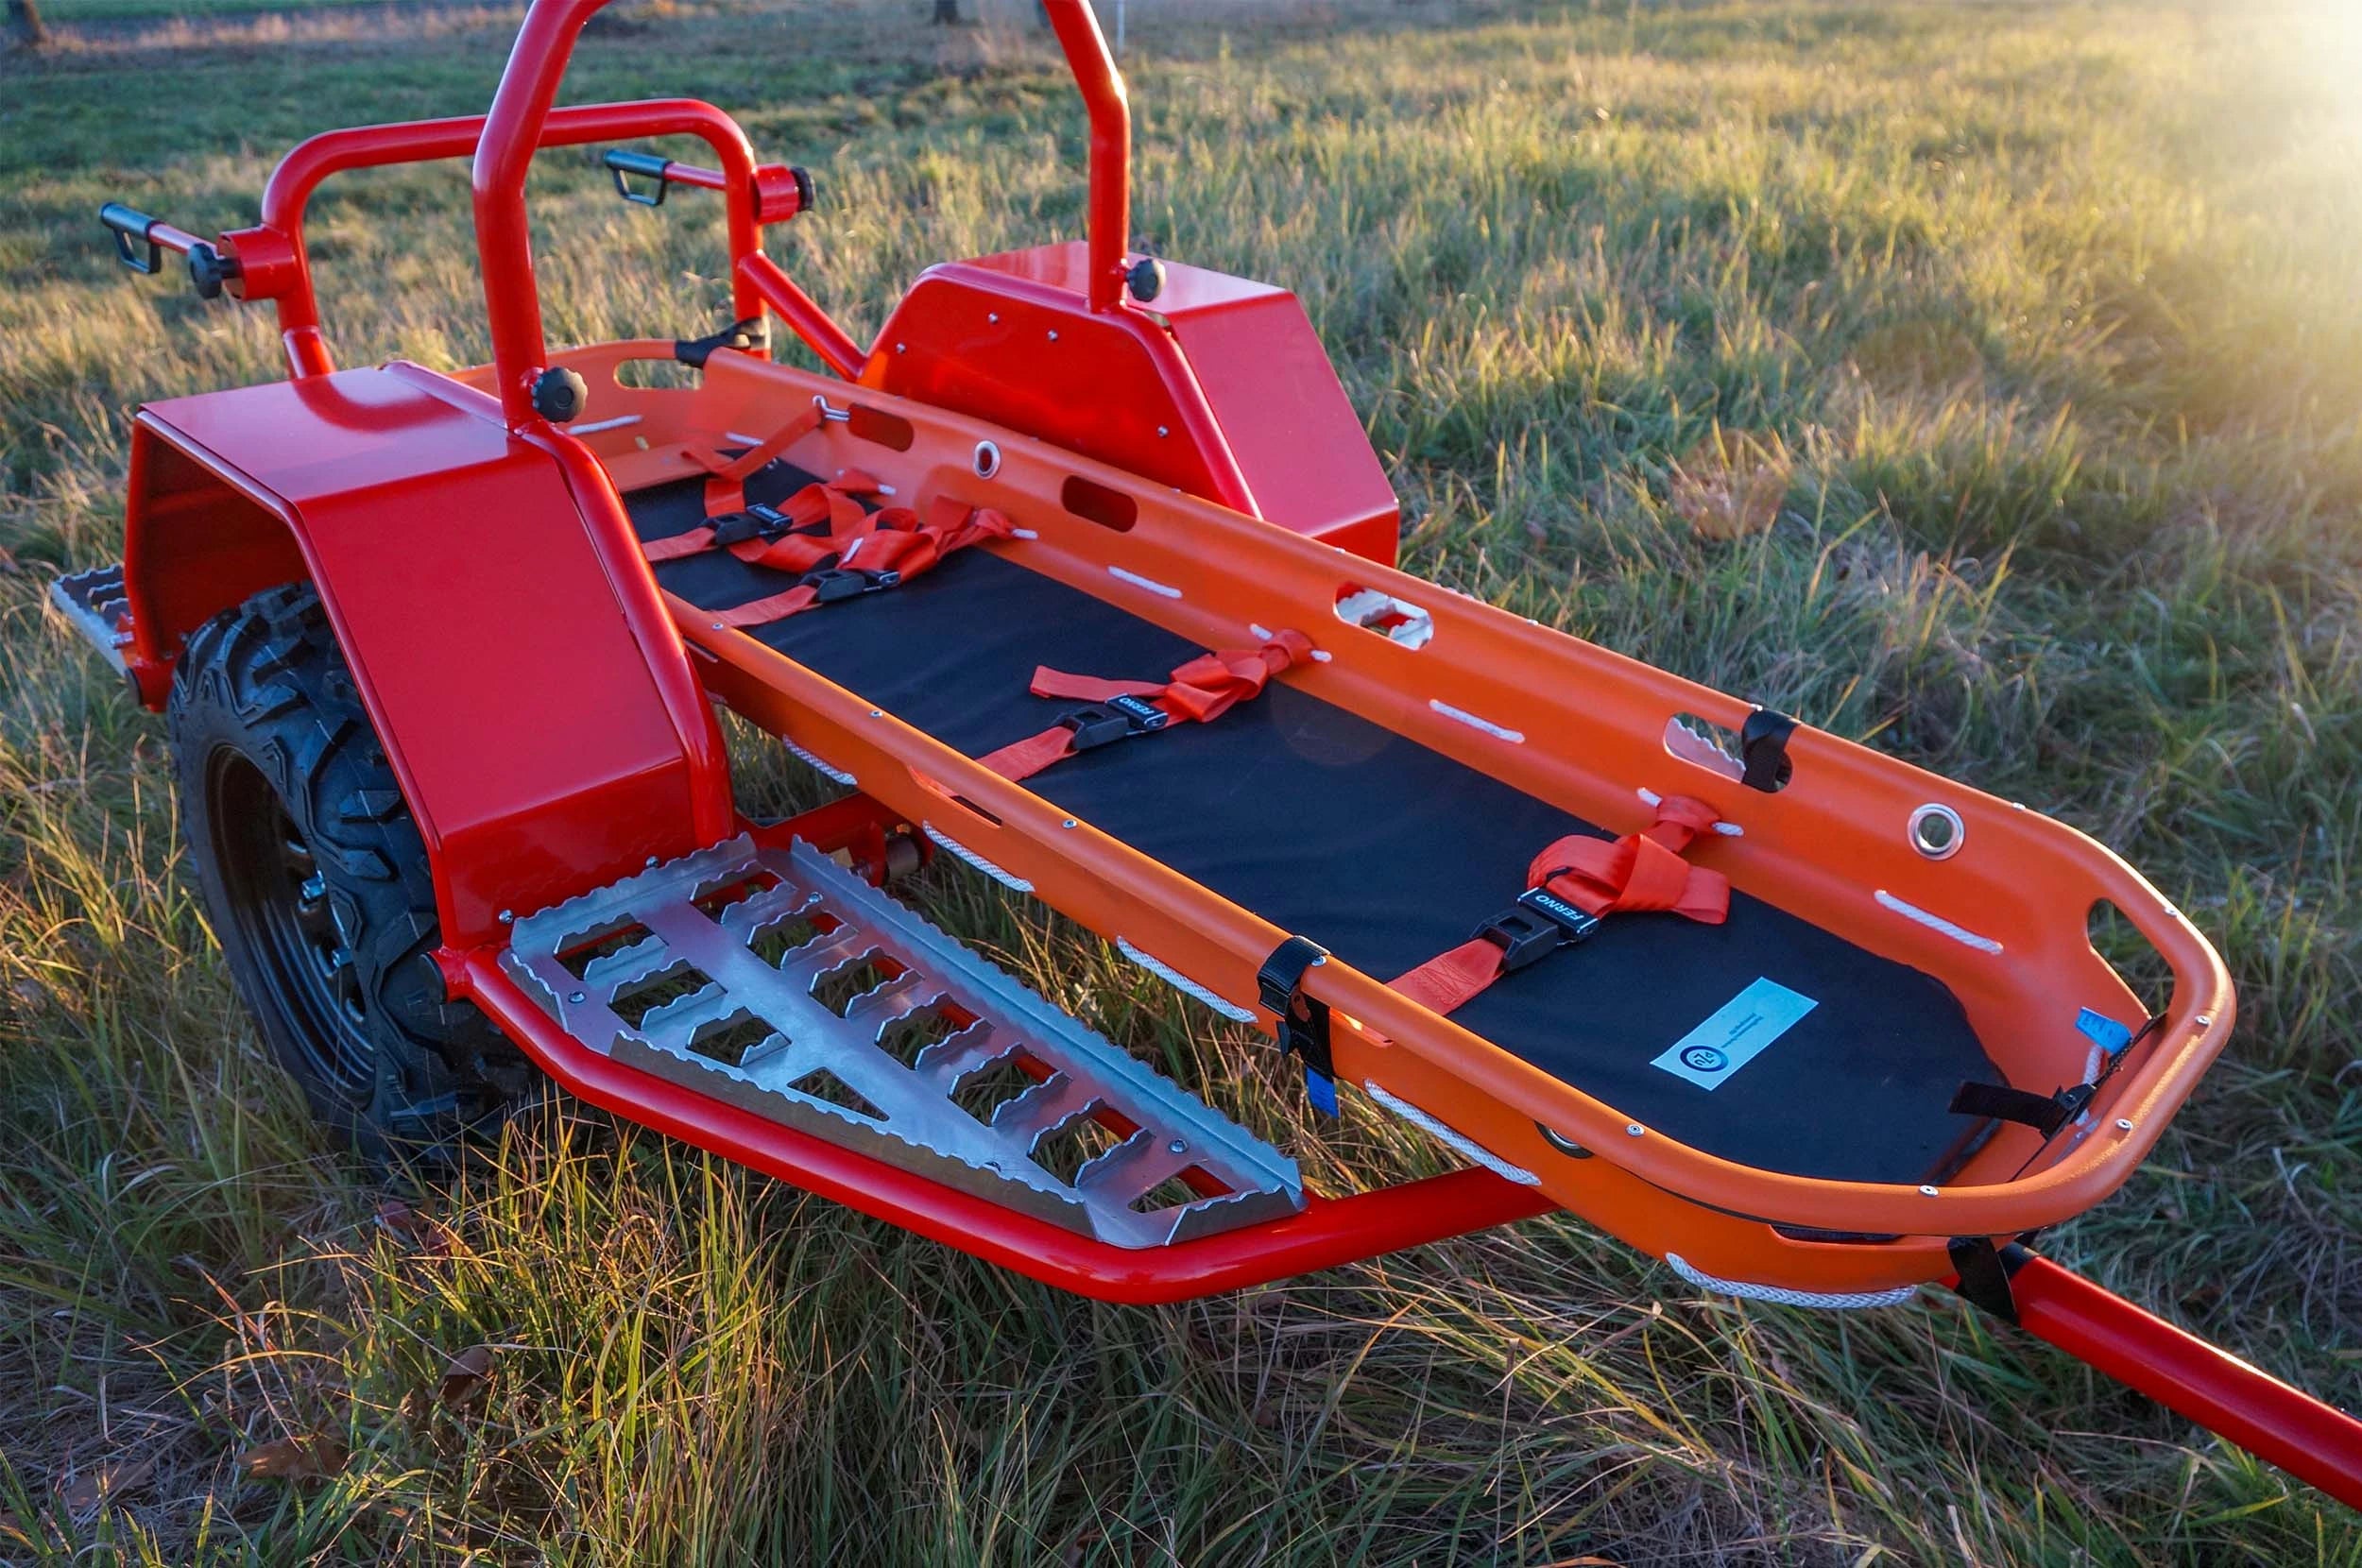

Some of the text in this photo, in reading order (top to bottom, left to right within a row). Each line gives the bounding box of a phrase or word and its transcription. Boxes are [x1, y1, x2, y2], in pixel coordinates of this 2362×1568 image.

[1119, 698, 1155, 715] FERNO
[1535, 895, 1584, 920] FERNO
[1694, 1051, 1715, 1066] PZU
